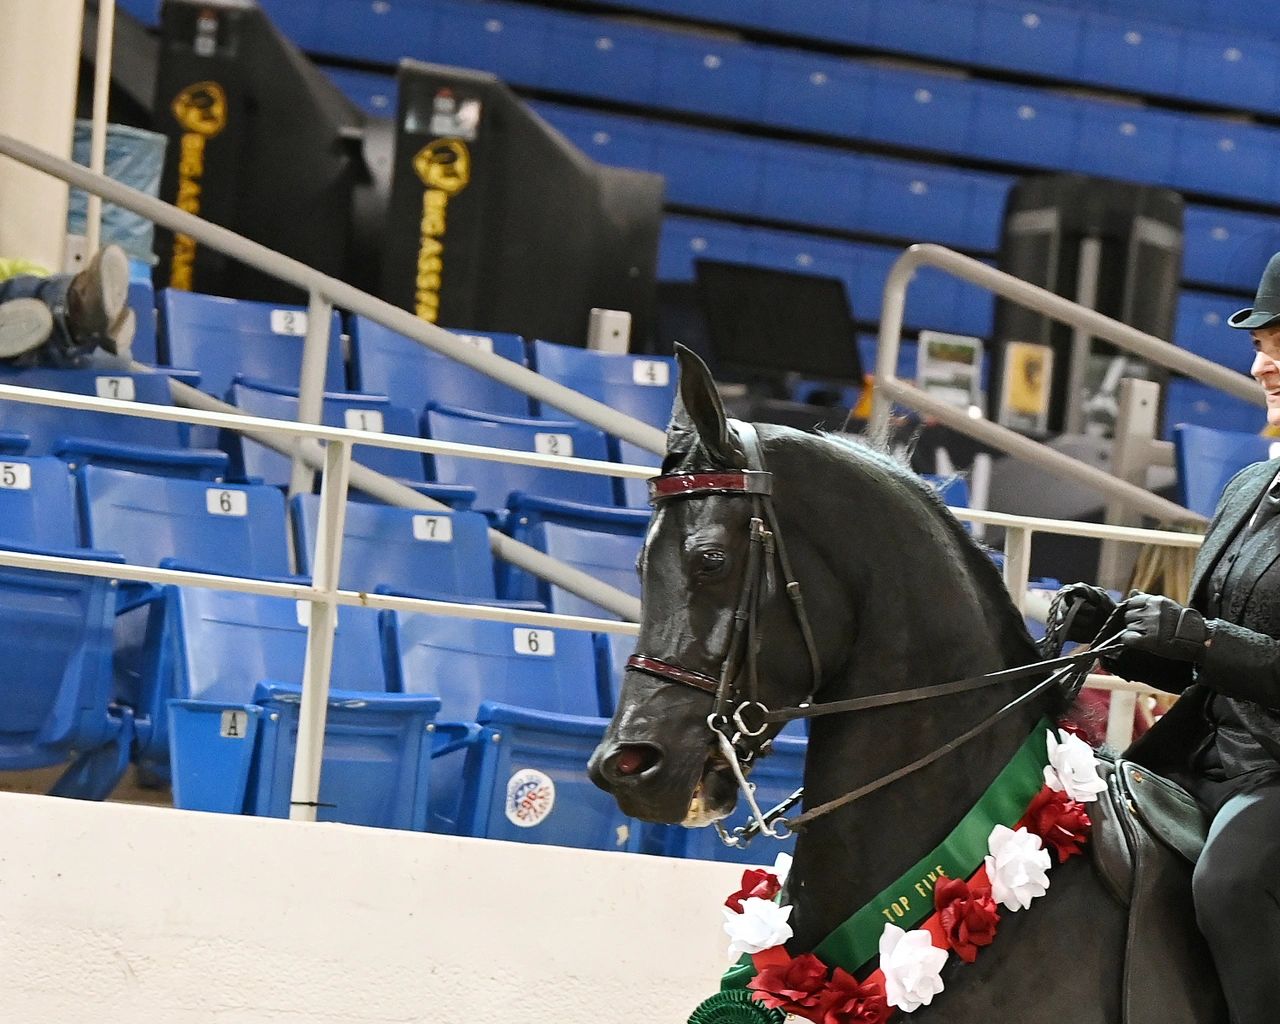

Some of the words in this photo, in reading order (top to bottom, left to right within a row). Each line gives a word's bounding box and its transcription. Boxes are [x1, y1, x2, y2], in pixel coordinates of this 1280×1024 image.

[283, 312, 295, 332] 2
[645, 360, 656, 381] 4
[108, 380, 120, 398] 7
[360, 414, 368, 431] 1
[548, 435, 559, 455] 2
[3, 466, 16, 486] 5
[220, 491, 232, 512] 6
[426, 519, 438, 538] 7
[528, 631, 539, 652] 6
[227, 711, 239, 736] A
[882, 896, 911, 922] TOP
